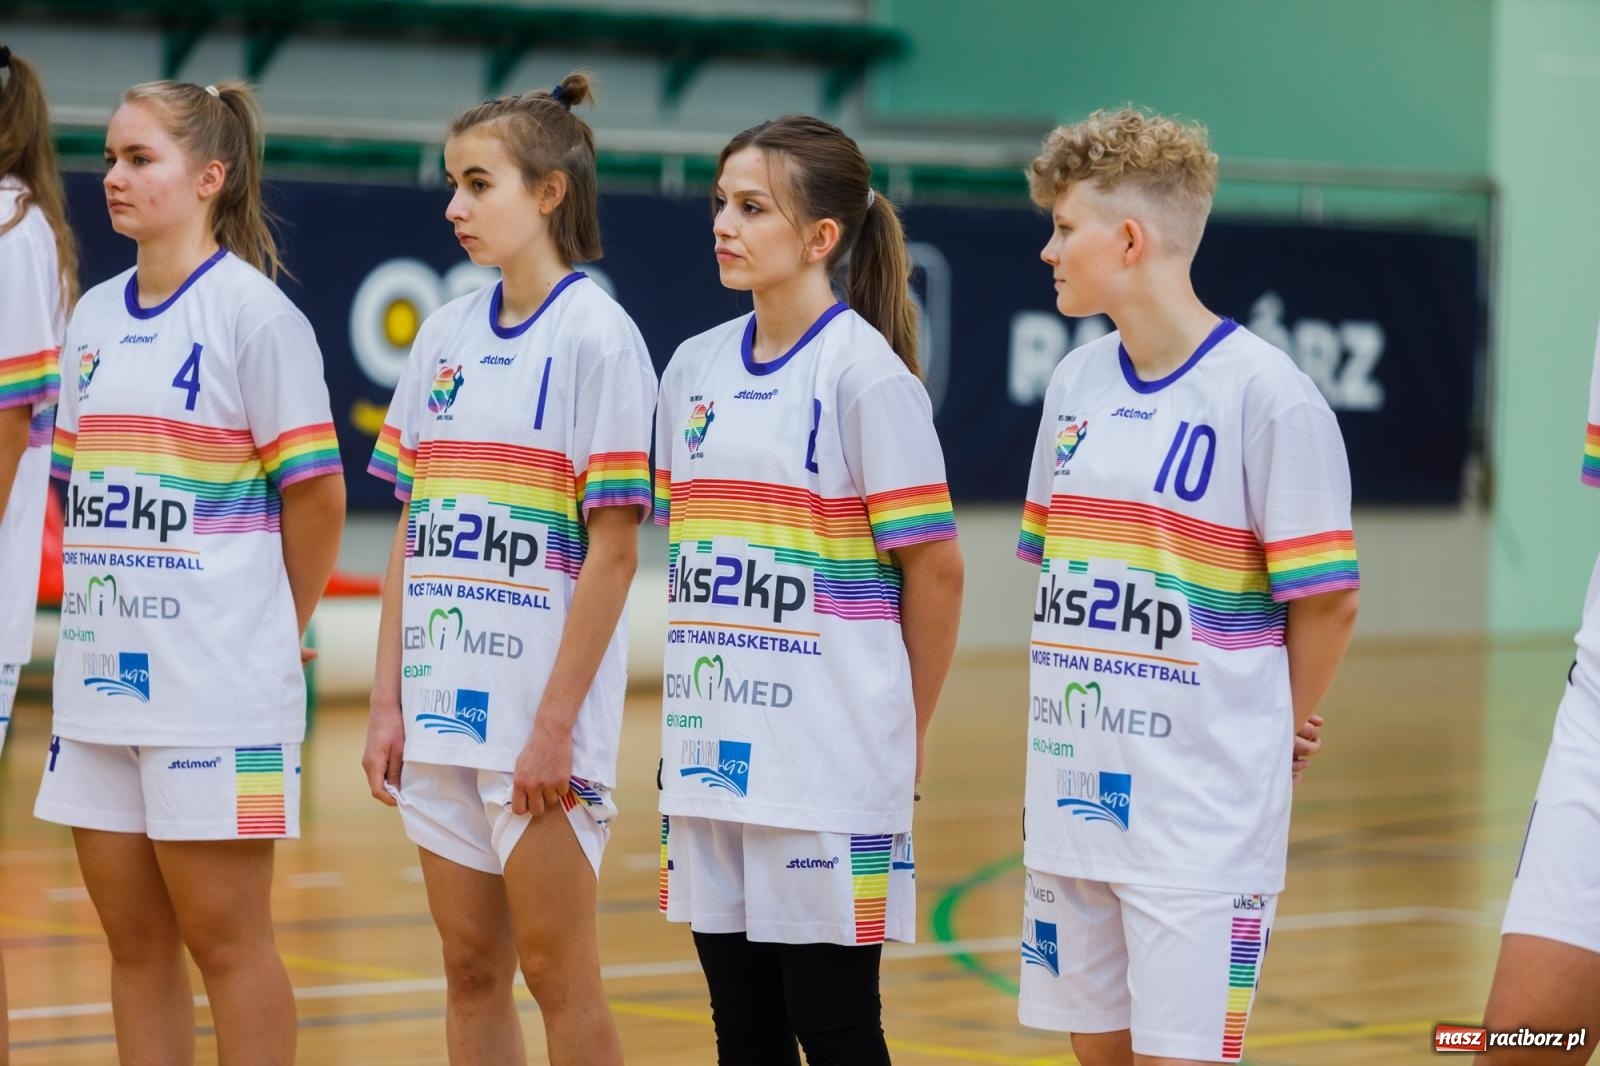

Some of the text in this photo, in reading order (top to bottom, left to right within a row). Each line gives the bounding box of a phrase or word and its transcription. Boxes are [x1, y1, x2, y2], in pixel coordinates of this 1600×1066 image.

[172, 342, 203, 411] 4
[1154, 420, 1216, 502] 10
[80, 552, 106, 566] THAN
[109, 554, 204, 571] BASKETBALL
[119, 595, 181, 619] MED
[425, 582, 453, 597] THAN
[457, 585, 551, 609] BASKETBALL
[464, 629, 524, 659] MED
[687, 629, 715, 645] THAN
[717, 631, 822, 656] BASKETBALL
[1032, 649, 1201, 686] MORE THAN BASKETBALL
[723, 677, 793, 708] MED
[1101, 706, 1172, 738] MED
